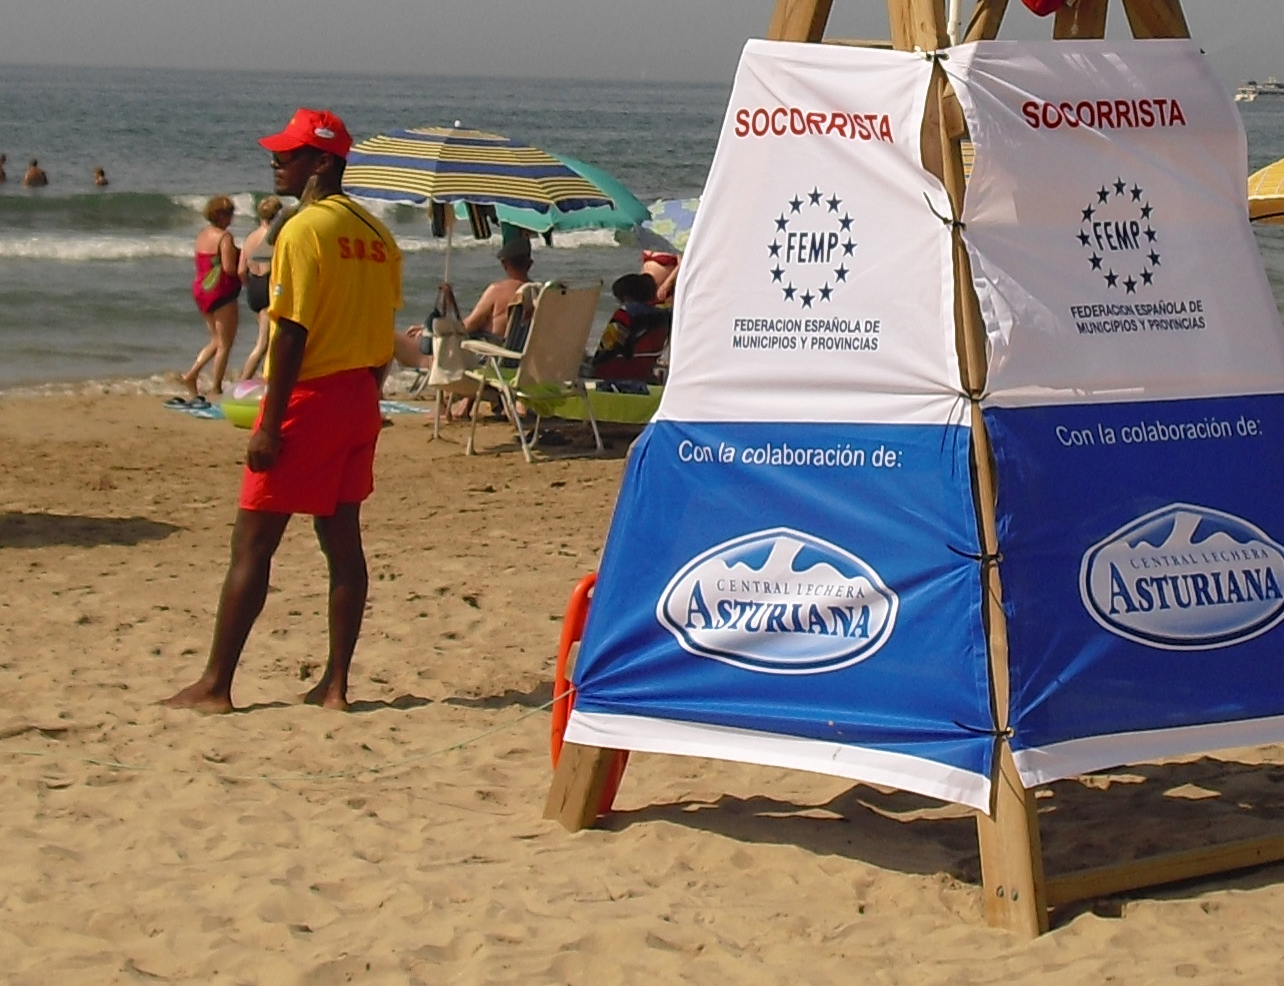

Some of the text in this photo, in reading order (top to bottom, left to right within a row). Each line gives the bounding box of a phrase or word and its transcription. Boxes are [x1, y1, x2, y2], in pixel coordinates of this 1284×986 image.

[734, 106, 895, 145] SOCORRISTA
[1022, 98, 1187, 131] SOCORRISTA
[785, 230, 839, 265] FEMP
[1092, 219, 1141, 253] FEMP
[1070, 299, 1204, 319] FEDERACION ESPAÑOLA DE
[733, 316, 881, 334] FEDERACION ESPAÑOLA DE
[1076, 316, 1206, 335] MUNICIPIOS Y PROVINCIAS
[732, 334, 879, 352] MUNICIPIOS Y PROVINCIAS
[1055, 415, 1264, 447] Con la colaboración de:
[678, 439, 904, 468] Con la colaboración de:
[1130, 548, 1270, 570] CENTRAL LECHERA
[716, 578, 866, 599] CENTRAL LECHERA
[1109, 561, 1284, 615] ASTURIANA
[684, 580, 870, 639] ASTURIANA
